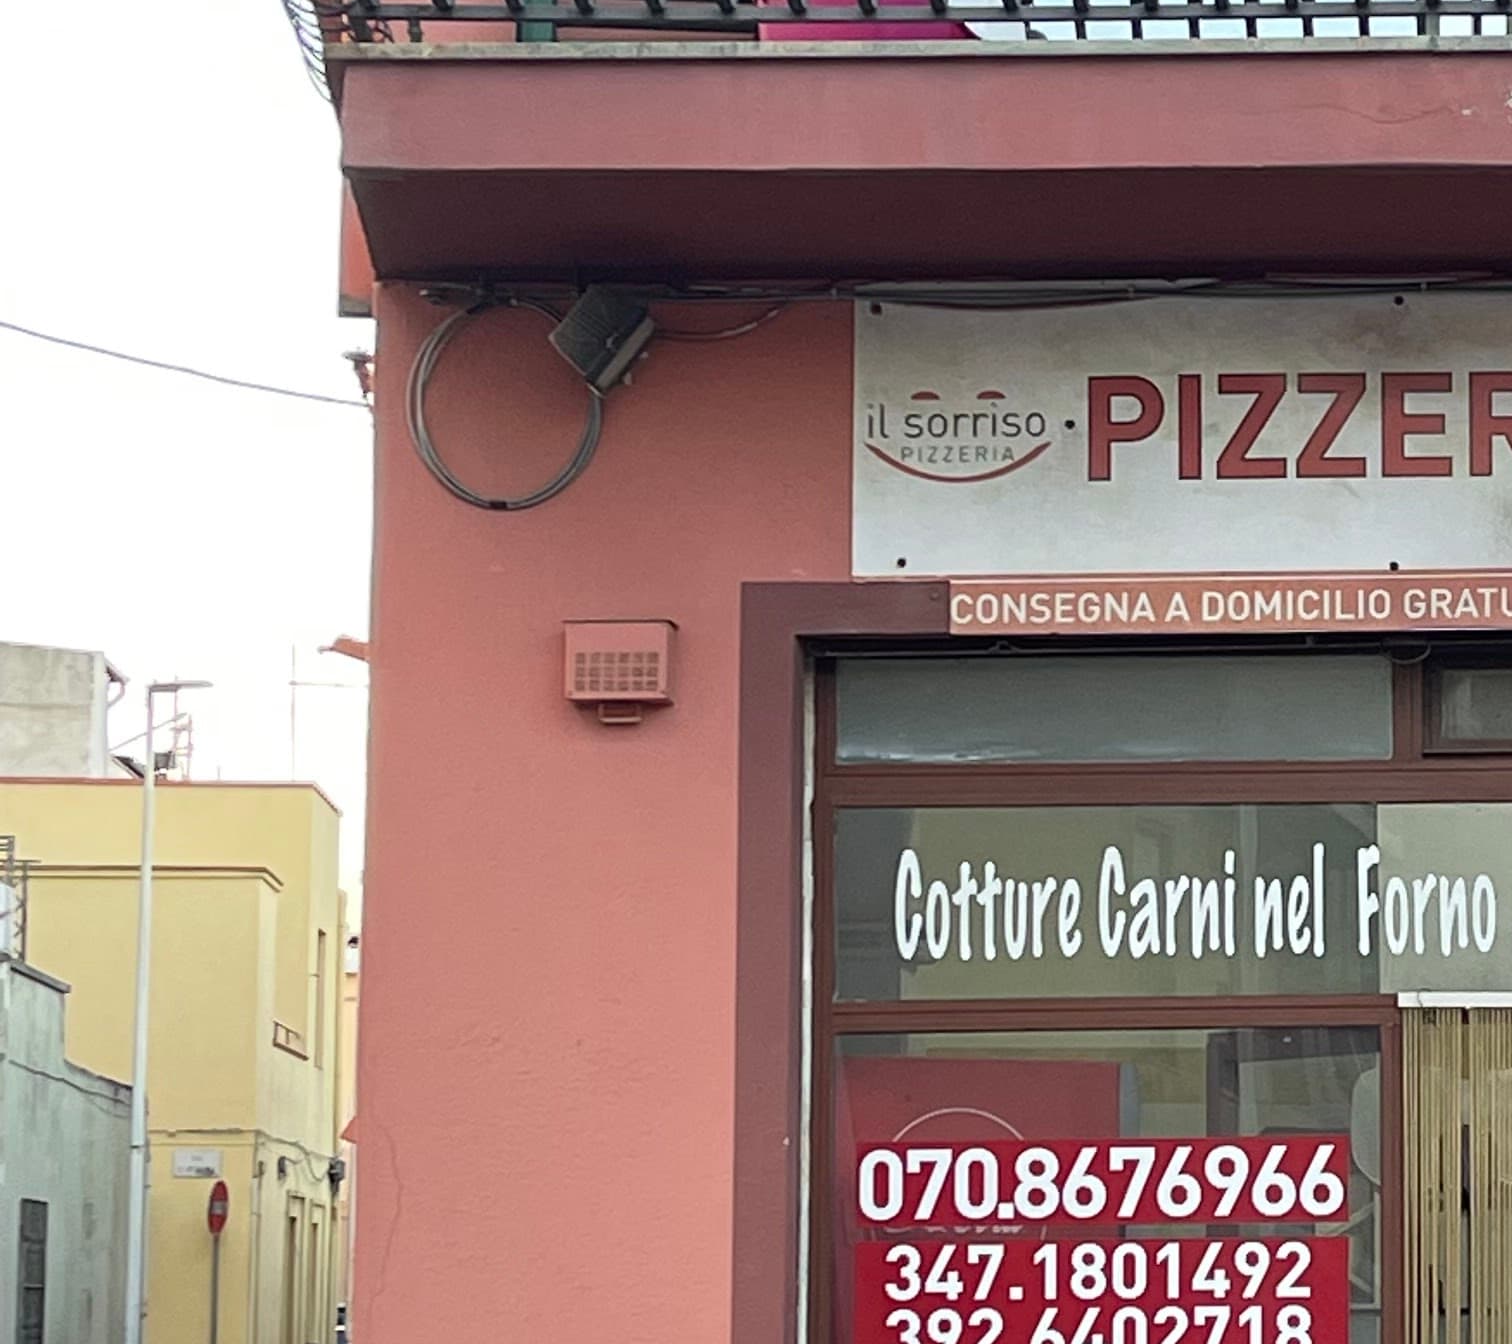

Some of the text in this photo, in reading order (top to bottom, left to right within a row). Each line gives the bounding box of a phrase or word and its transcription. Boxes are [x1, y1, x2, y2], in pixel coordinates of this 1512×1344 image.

[865, 402, 1046, 439] il sorriso
[901, 445, 1015, 464] PIZZERIA
[951, 591, 1156, 624] CONSEGNA
[1164, 591, 1190, 622] A
[1202, 588, 1392, 622] DOMICILIO
[894, 848, 1082, 961] Cotture
[1098, 846, 1236, 960] Carni
[1254, 843, 1325, 959] nel
[1357, 844, 1497, 957] Forno
[858, 1144, 1345, 1221] 070.8676966
[884, 1241, 1312, 1301] 347.1801492
